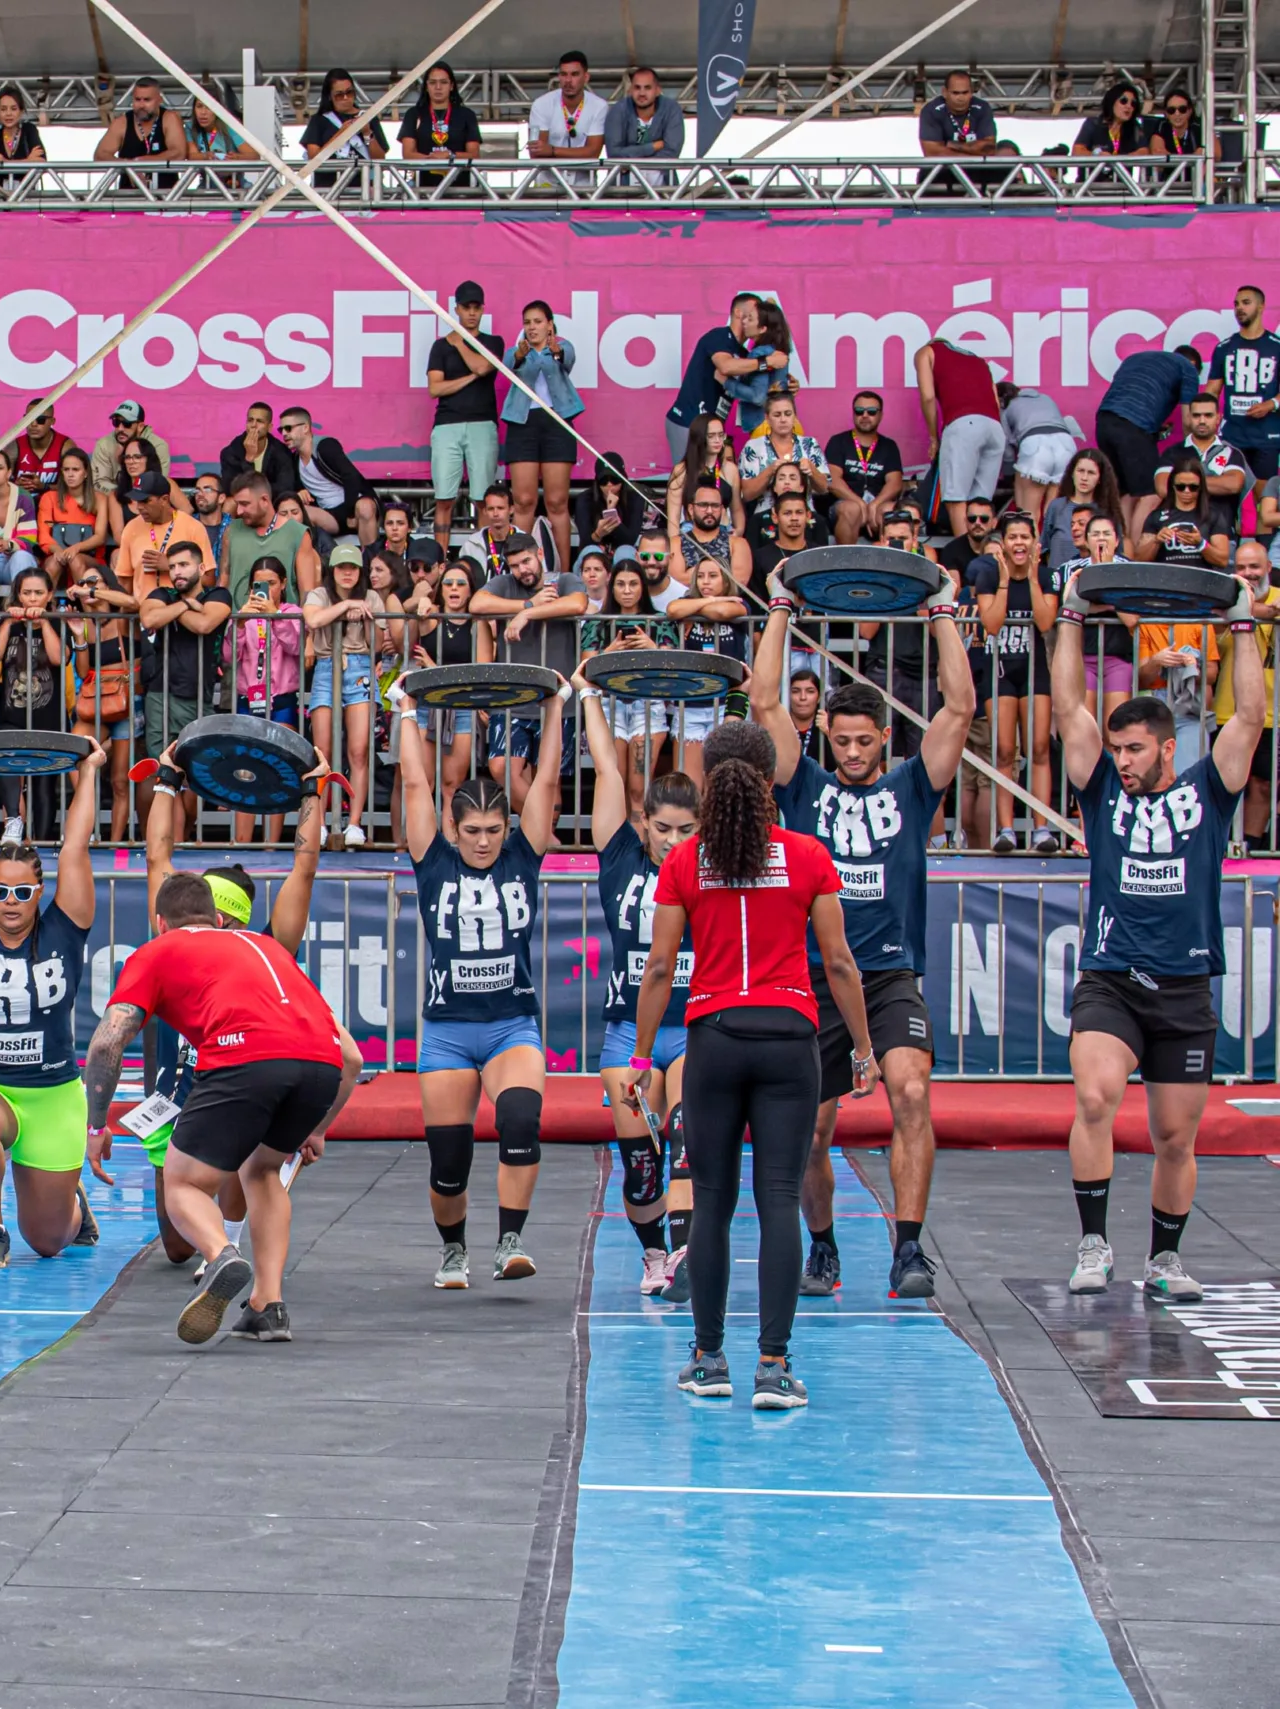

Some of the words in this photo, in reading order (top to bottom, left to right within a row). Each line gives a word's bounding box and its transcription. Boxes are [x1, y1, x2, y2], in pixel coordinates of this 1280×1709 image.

[1128, 863, 1179, 880] CrossFit
[436, 873, 531, 952] ERB
[457, 962, 511, 979] CrossFit
[217, 1032, 245, 1046] WILL
